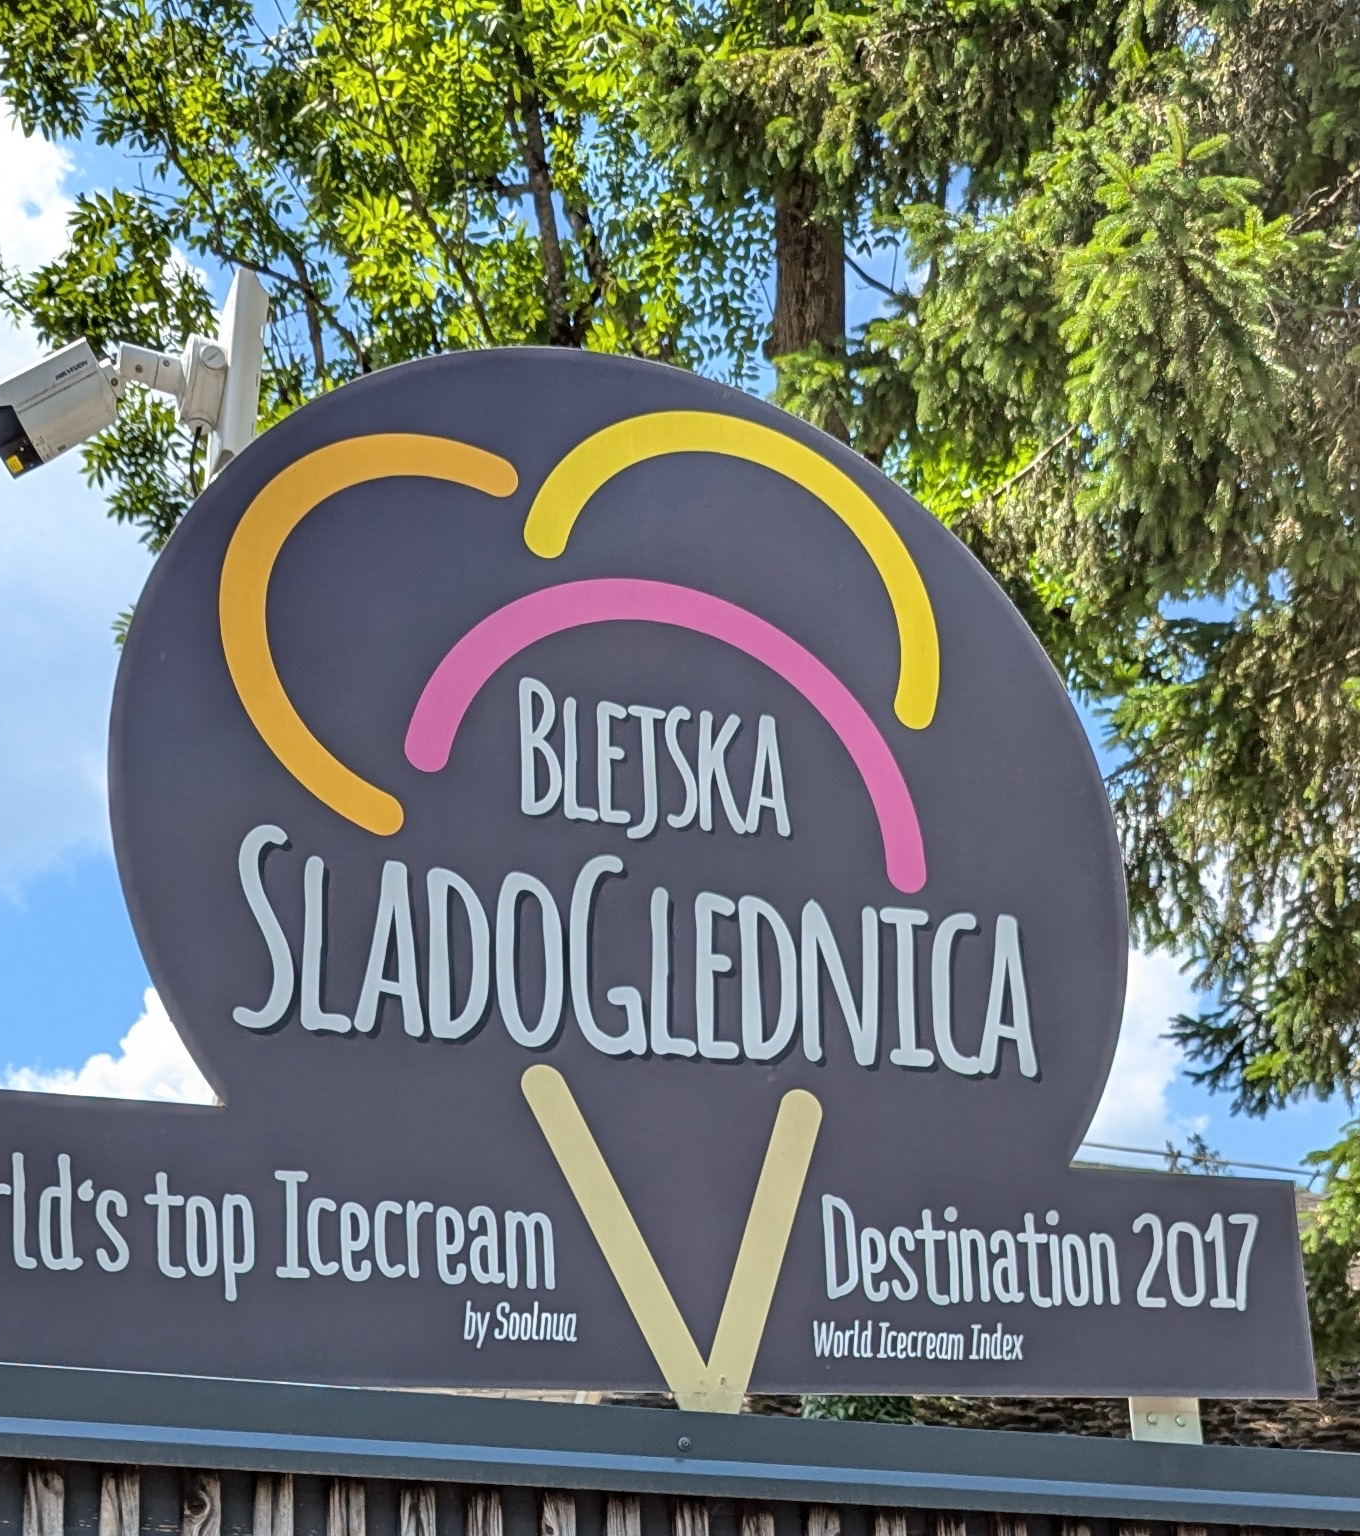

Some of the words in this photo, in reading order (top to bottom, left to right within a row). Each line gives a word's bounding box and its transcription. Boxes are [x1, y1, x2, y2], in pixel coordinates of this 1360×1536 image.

[519, 677, 790, 838] BLEJSKA
[233, 826, 1037, 1077] SLADOGLEDNICA
[149, 1172, 254, 1301] top
[275, 1170, 555, 1289] Icecream
[822, 1194, 1120, 1308] Destination
[1132, 1213, 1258, 1311] 2017
[464, 1300, 491, 1349] by
[493, 1301, 578, 1342] Soolnua
[813, 1319, 873, 1358] World
[876, 1322, 964, 1360] Icecream
[968, 1322, 1024, 1360] Index
